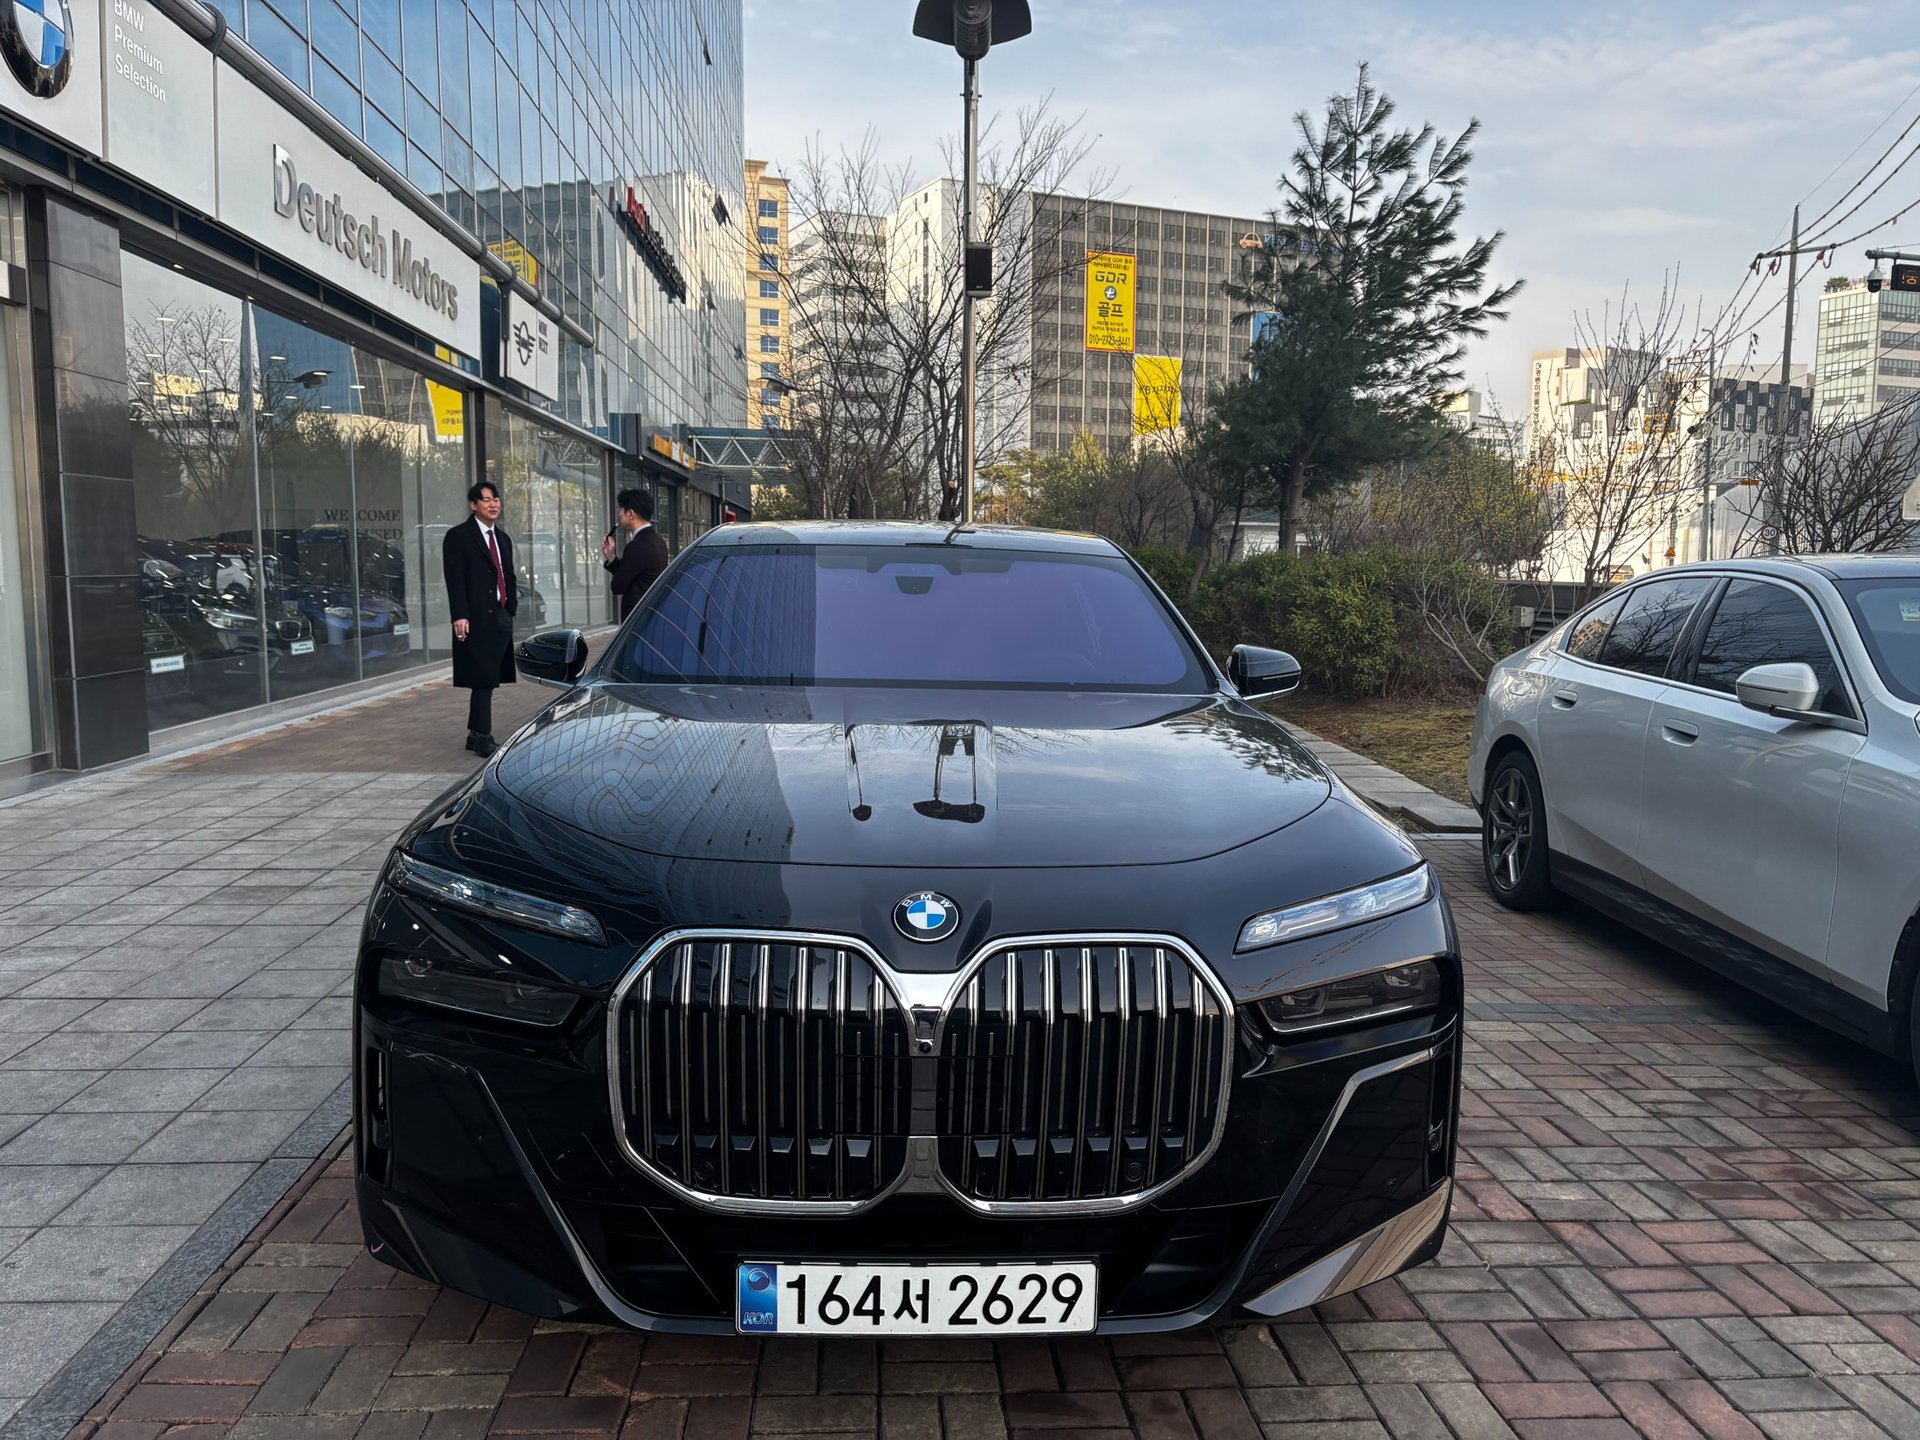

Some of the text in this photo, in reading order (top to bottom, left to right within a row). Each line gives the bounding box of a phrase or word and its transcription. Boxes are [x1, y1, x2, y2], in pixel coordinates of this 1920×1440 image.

[114, 0, 144, 32] BMW
[114, 24, 163, 74] Premium
[115, 53, 166, 103] Selection
[273, 144, 458, 321] Deutsch Motors
[1095, 271, 1127, 284] GDR
[1097, 301, 1123, 317] 골프
[324, 509, 401, 521] WECOME
[1764, 529, 1776, 537] 30
[902, 894, 952, 908] BMW
[786, 1272, 1083, 1326] 164서 2629
[743, 1312, 775, 1325] KOR
